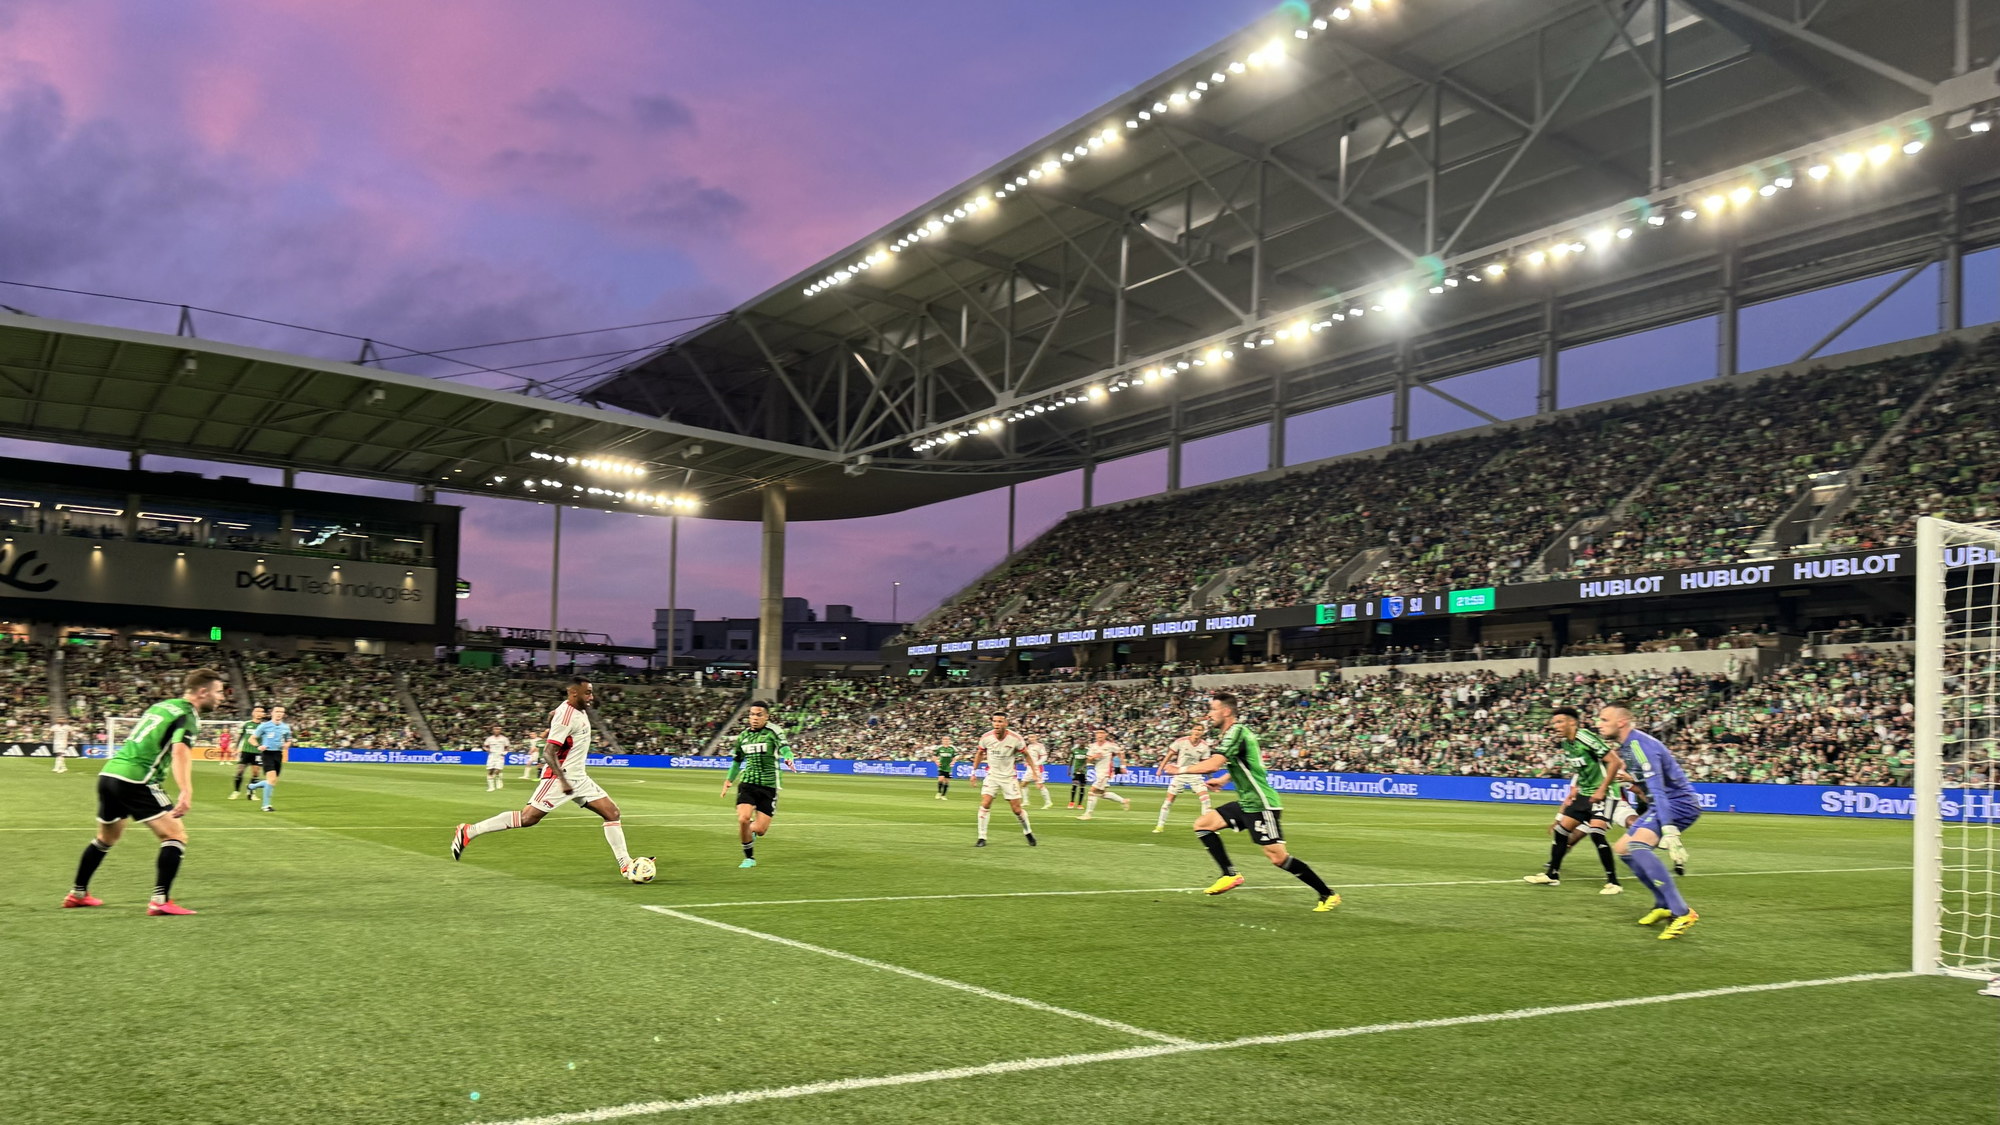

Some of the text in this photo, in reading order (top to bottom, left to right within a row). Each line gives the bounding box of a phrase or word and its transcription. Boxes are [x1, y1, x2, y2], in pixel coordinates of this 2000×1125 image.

[236, 571, 425, 604] DELL Technologies
[1580, 553, 1901, 598] HUBLOT HUBLOT HUBLOT
[1102, 625, 1146, 639] HUBLOT
[1151, 620, 1199, 635] HUBLOT
[1205, 614, 1257, 631] HUBLOT
[740, 743, 768, 754] YETI
